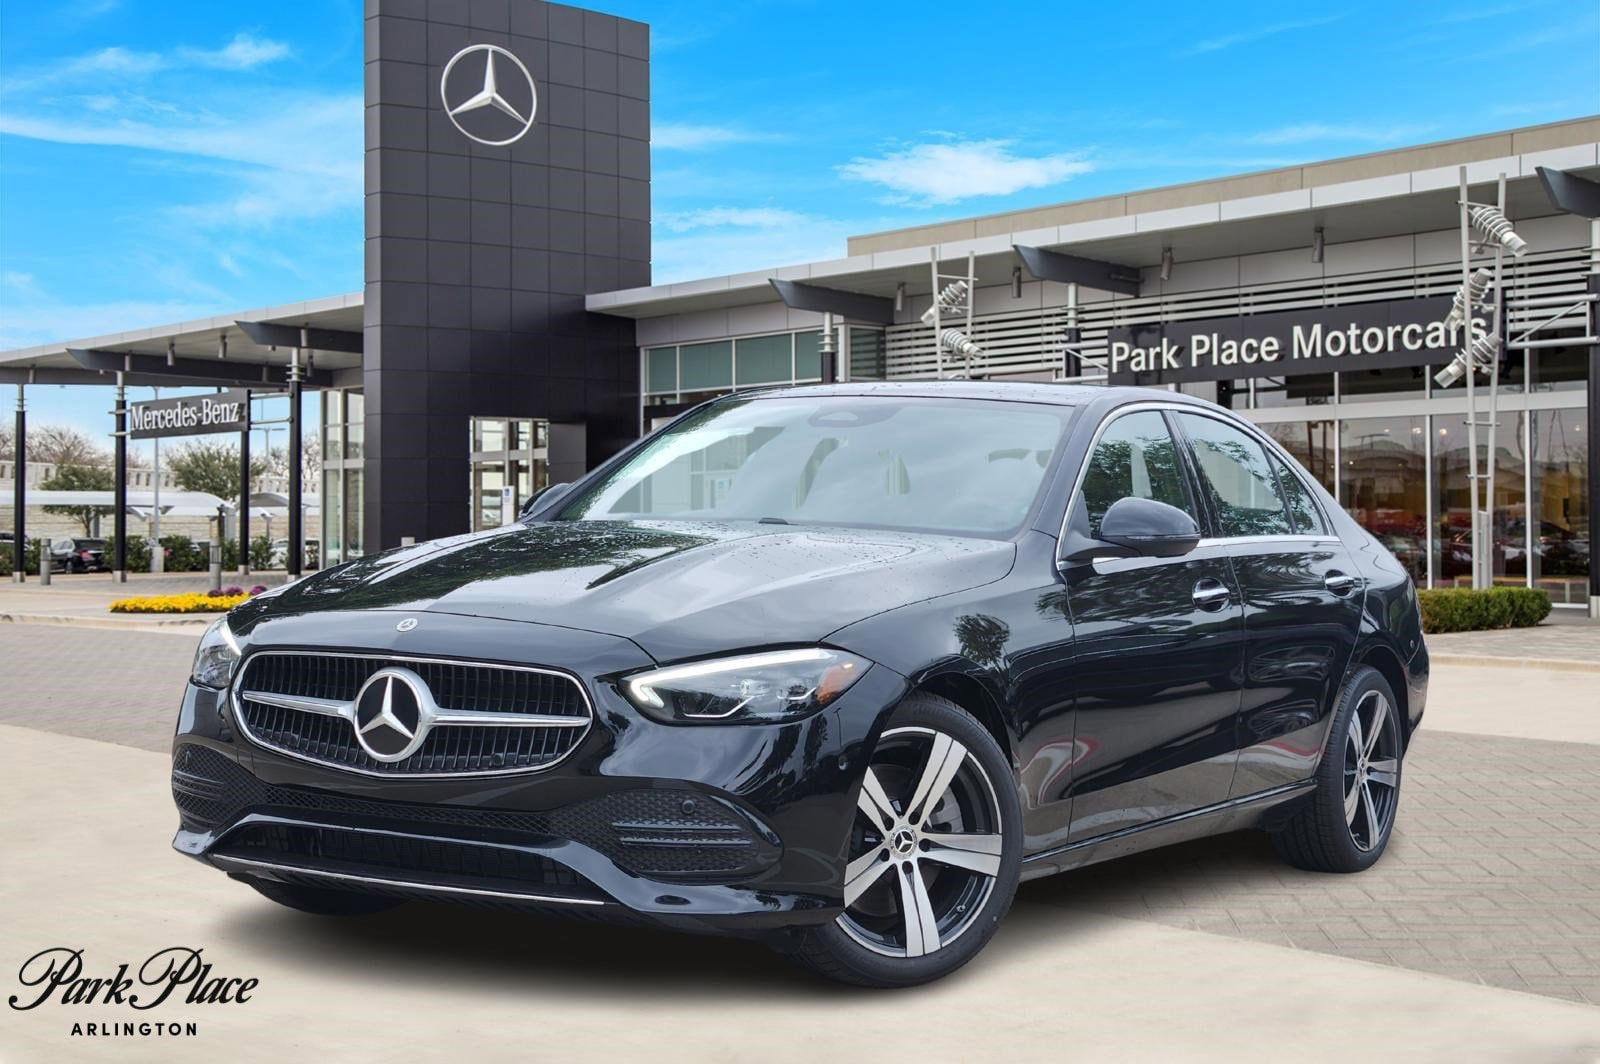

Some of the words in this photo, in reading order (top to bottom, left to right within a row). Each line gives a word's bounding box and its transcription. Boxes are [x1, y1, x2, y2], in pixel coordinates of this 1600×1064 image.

[1111, 337, 1179, 373] Park
[1191, 333, 1281, 366] Place
[1292, 316, 1488, 359] Motorcars
[131, 399, 239, 431] Mercedes-Benz
